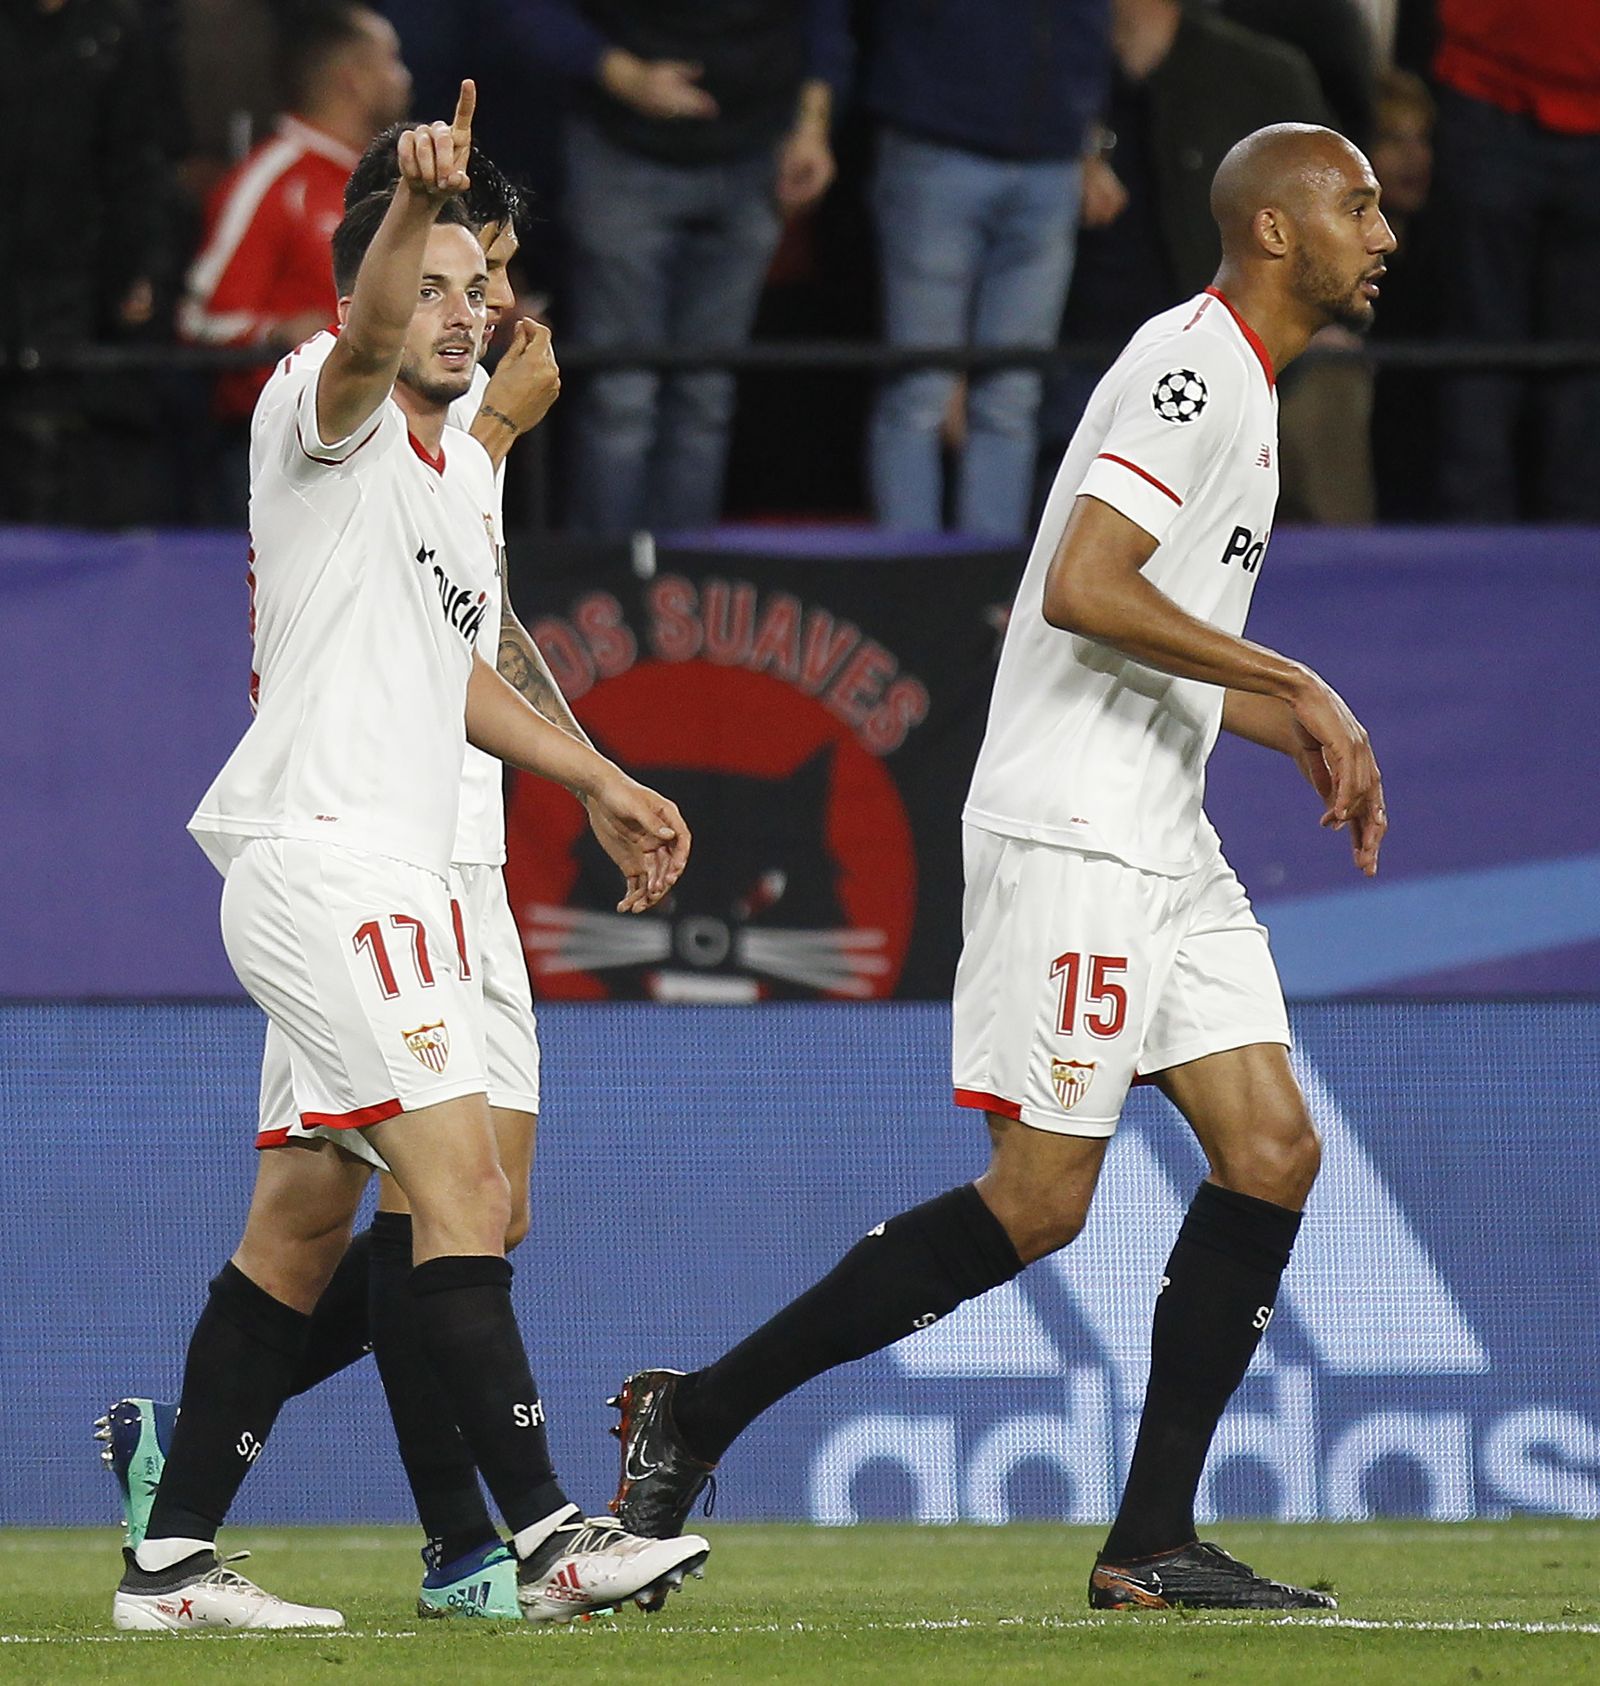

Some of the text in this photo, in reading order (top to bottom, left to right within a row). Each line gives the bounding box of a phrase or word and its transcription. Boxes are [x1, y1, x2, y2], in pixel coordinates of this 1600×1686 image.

[646, 573, 930, 756] SUAVES
[352, 913, 436, 1001] 17
[1049, 951, 1128, 1041] 15
[809, 1366, 1600, 1524] addas
